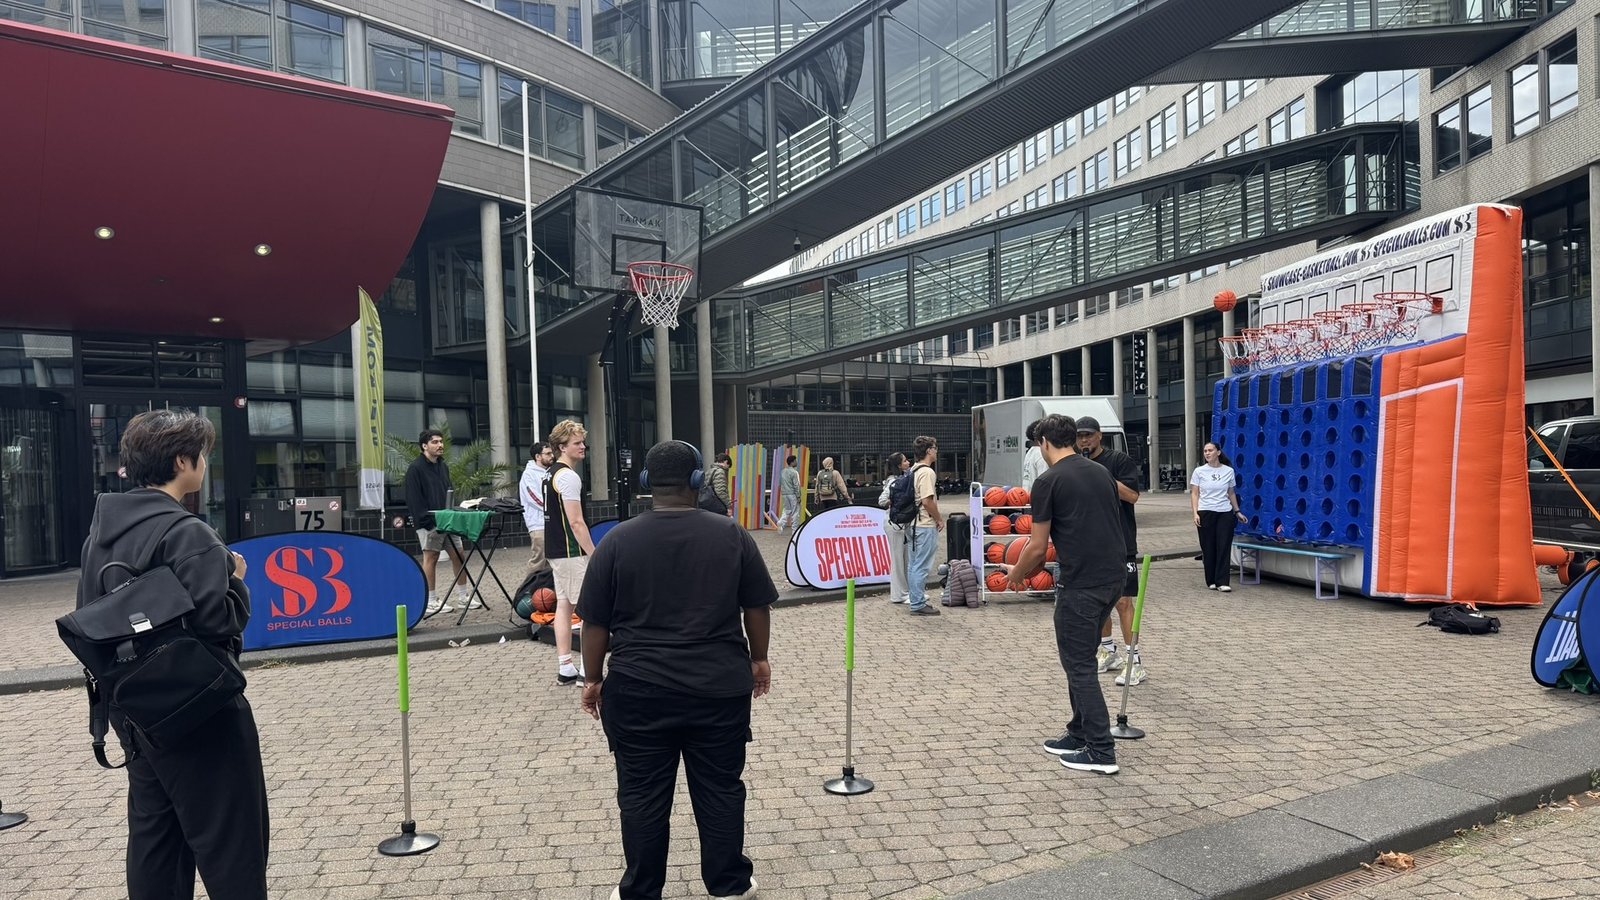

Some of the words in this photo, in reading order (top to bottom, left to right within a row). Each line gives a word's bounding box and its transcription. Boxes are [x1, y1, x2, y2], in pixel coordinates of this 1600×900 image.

[618, 213, 661, 228] TARMAK
[1372, 218, 1451, 257] SPECIALBALLS.COM
[300, 510, 325, 530] 75
[815, 536, 871, 582] SPECIAL
[267, 619, 315, 632] SPECIAL
[318, 616, 352, 626] BALLS
